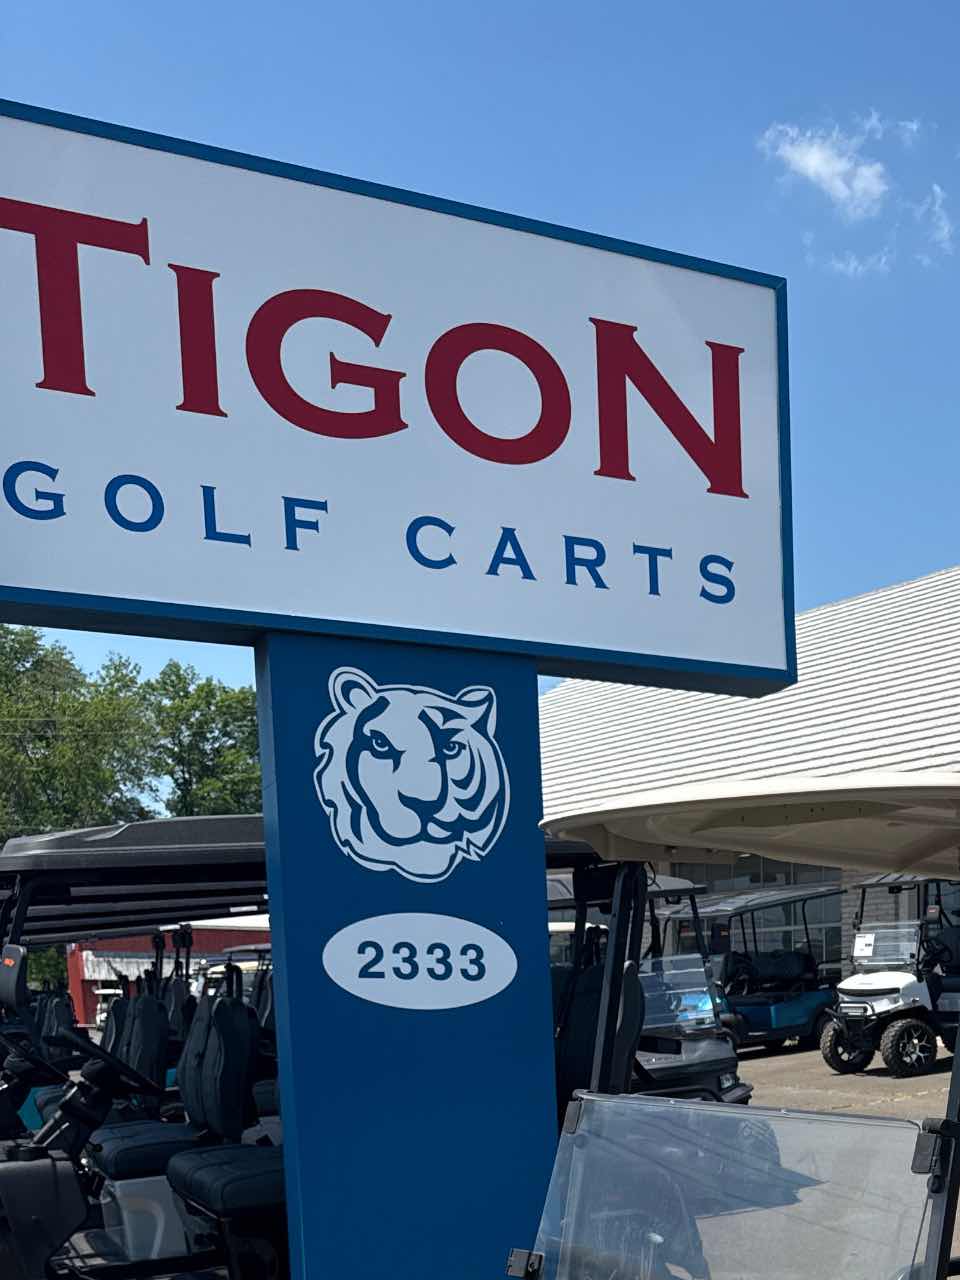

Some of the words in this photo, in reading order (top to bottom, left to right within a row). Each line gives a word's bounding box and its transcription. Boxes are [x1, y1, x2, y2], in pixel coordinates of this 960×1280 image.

[0, 197, 749, 498] TIGON
[2, 460, 329, 552] GOLF
[405, 515, 737, 605] CARTS
[357, 940, 487, 982] 2333
